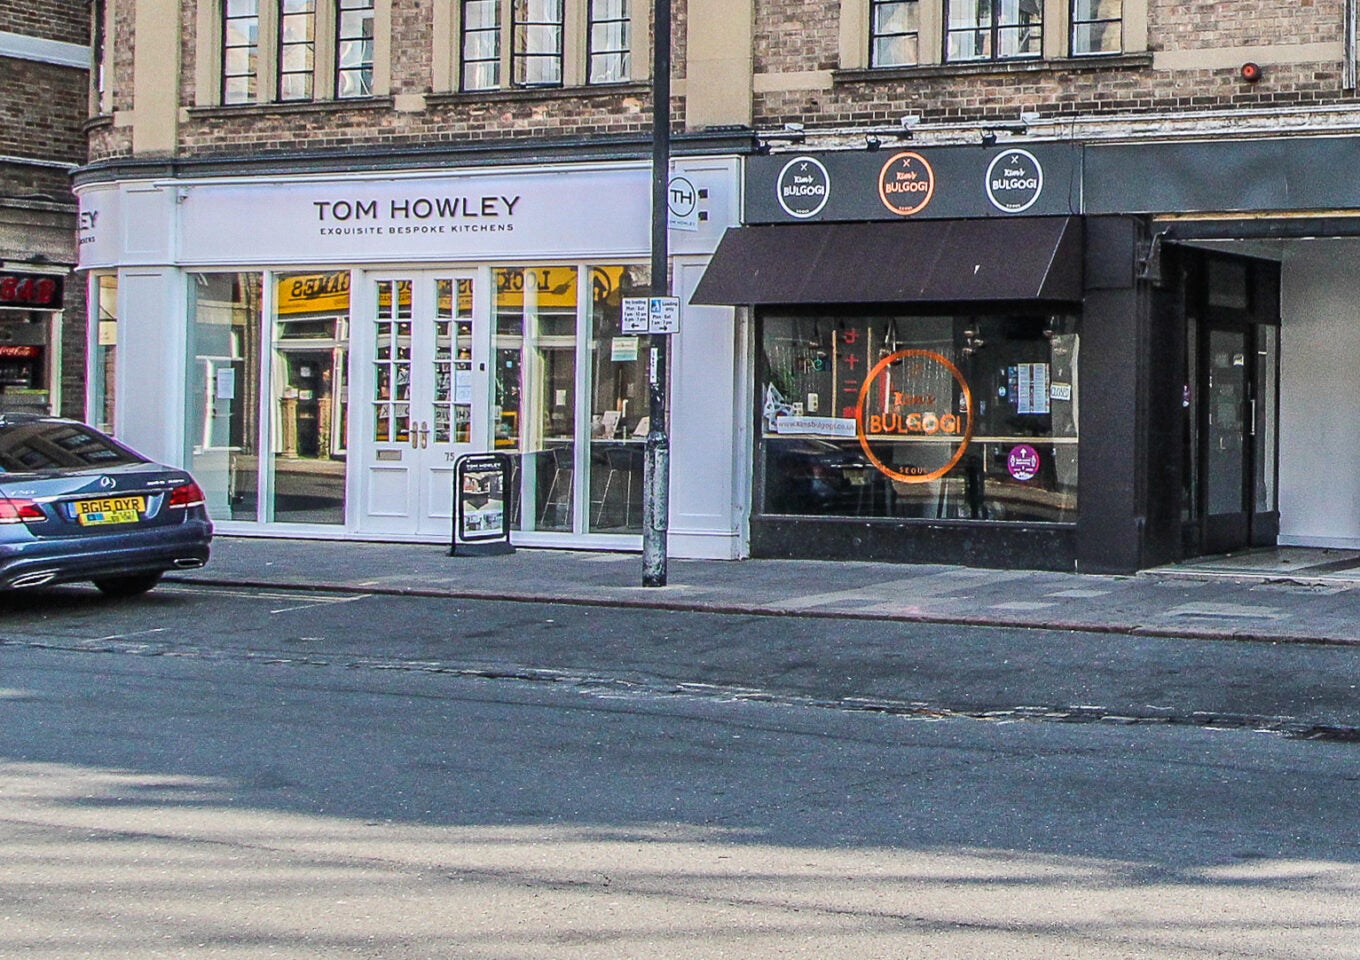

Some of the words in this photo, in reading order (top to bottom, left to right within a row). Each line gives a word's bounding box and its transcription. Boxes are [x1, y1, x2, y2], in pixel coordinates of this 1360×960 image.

[885, 181, 929, 194] BULGOGI
[992, 178, 1038, 190] BULGOGI
[783, 185, 825, 196] BULGOGI
[670, 189, 692, 205] TH
[313, 200, 378, 221] TOM
[390, 195, 521, 219] HOWLEY
[320, 226, 384, 235] EXQUISITE
[388, 225, 446, 234] BESPOKE
[451, 224, 515, 233] KITCHENS
[869, 412, 962, 434] BULGOGI
[445, 452, 455, 461] 75
